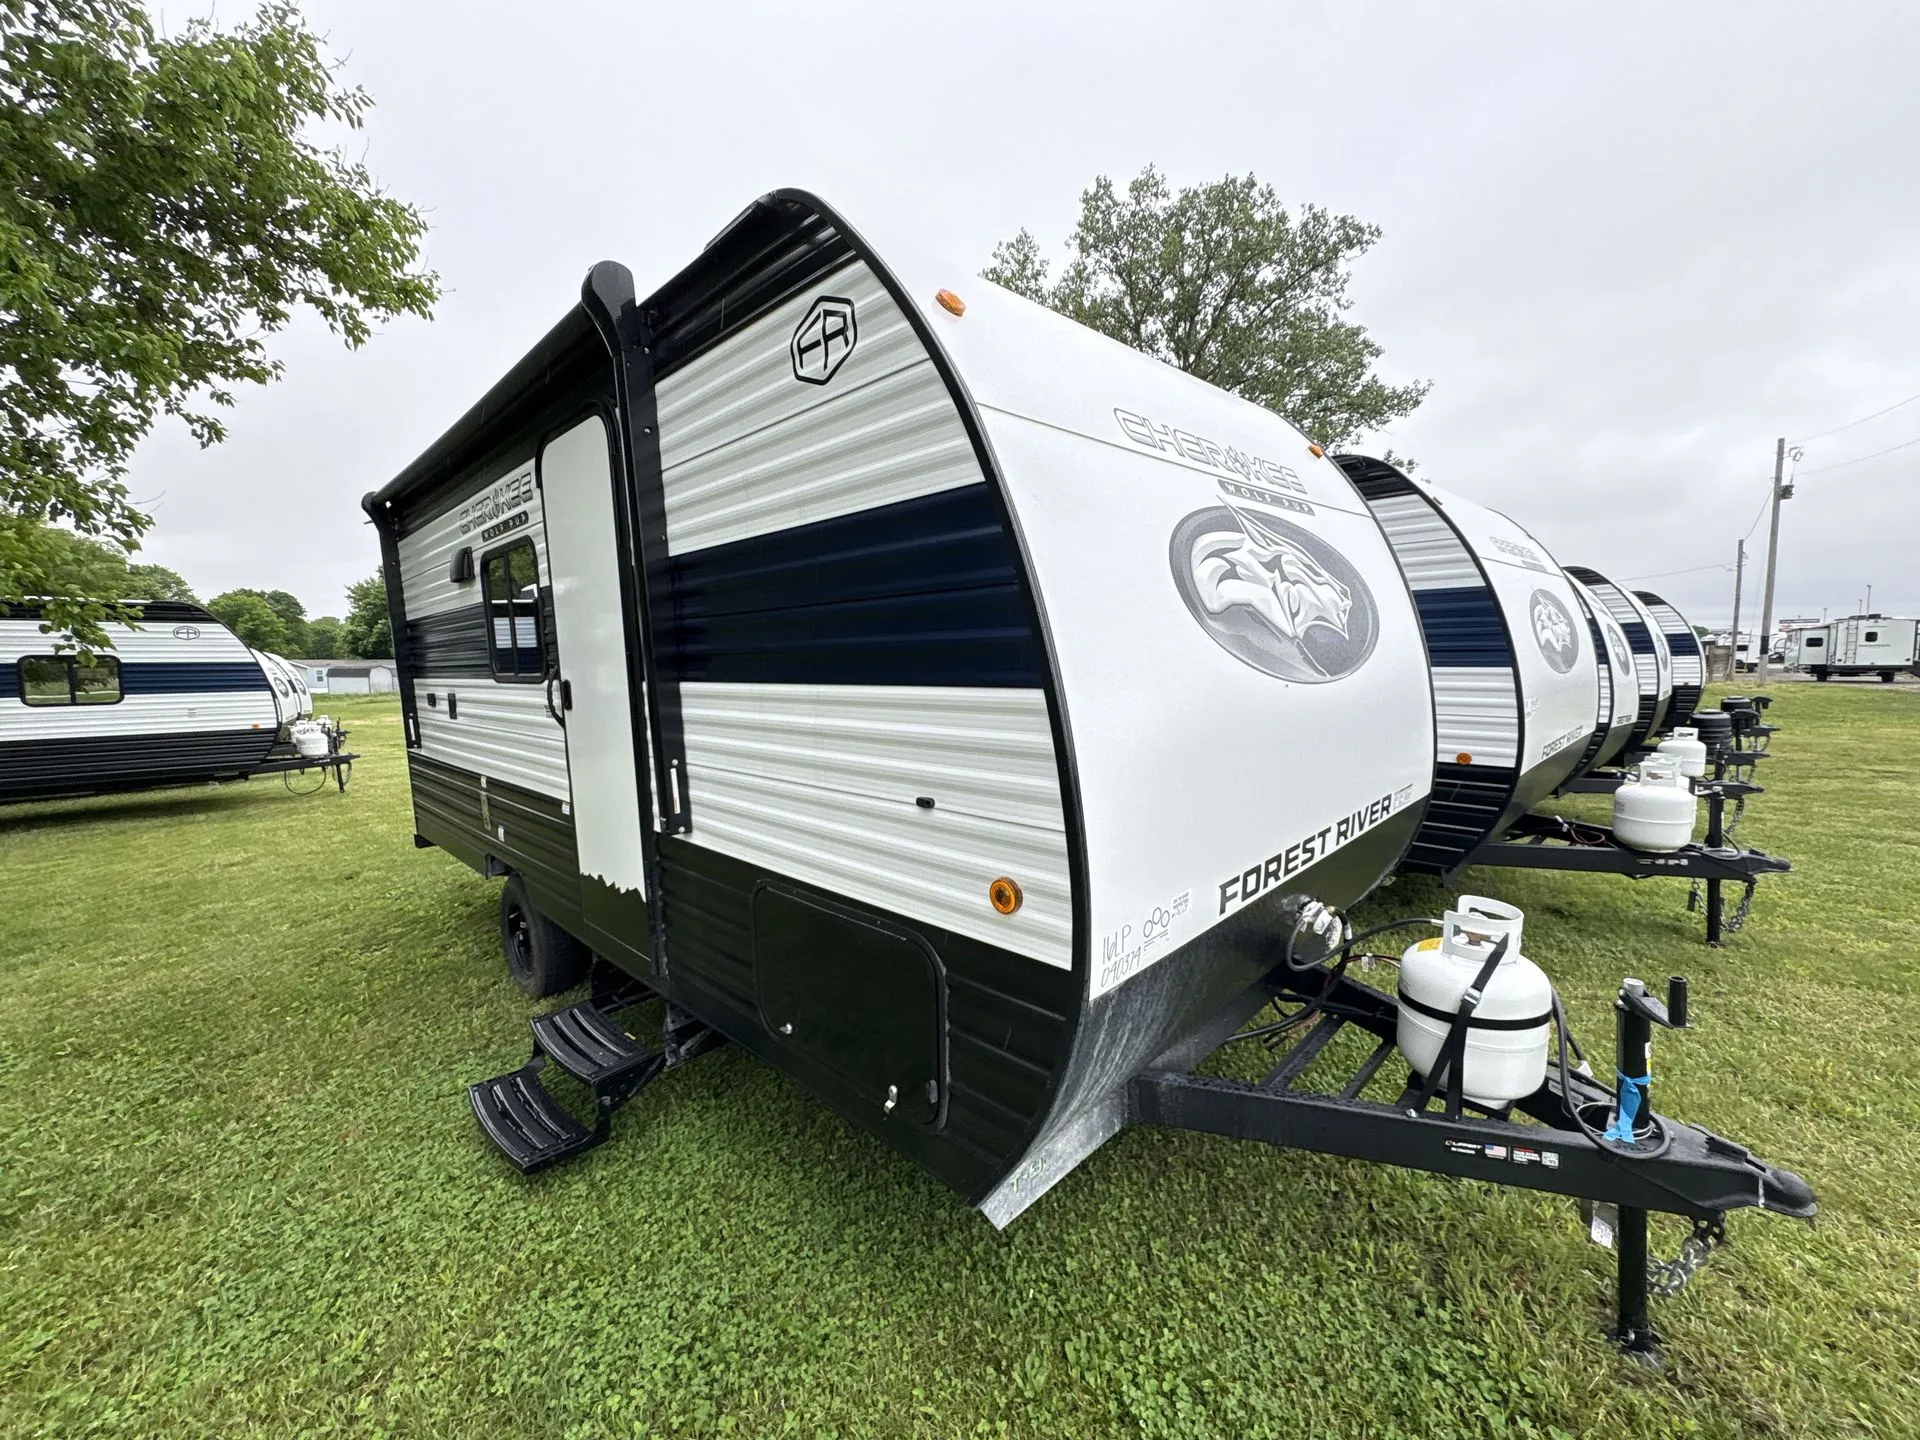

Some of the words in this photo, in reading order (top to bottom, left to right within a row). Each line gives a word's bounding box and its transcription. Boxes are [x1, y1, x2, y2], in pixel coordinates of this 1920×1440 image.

[1225, 483, 1272, 504] WOLF
[1281, 498, 1311, 513] PUP
[483, 523, 504, 539] WOLF
[508, 513, 527, 528] PUP
[1218, 825, 1331, 917] FOREST
[1335, 793, 1393, 847] RIVER
